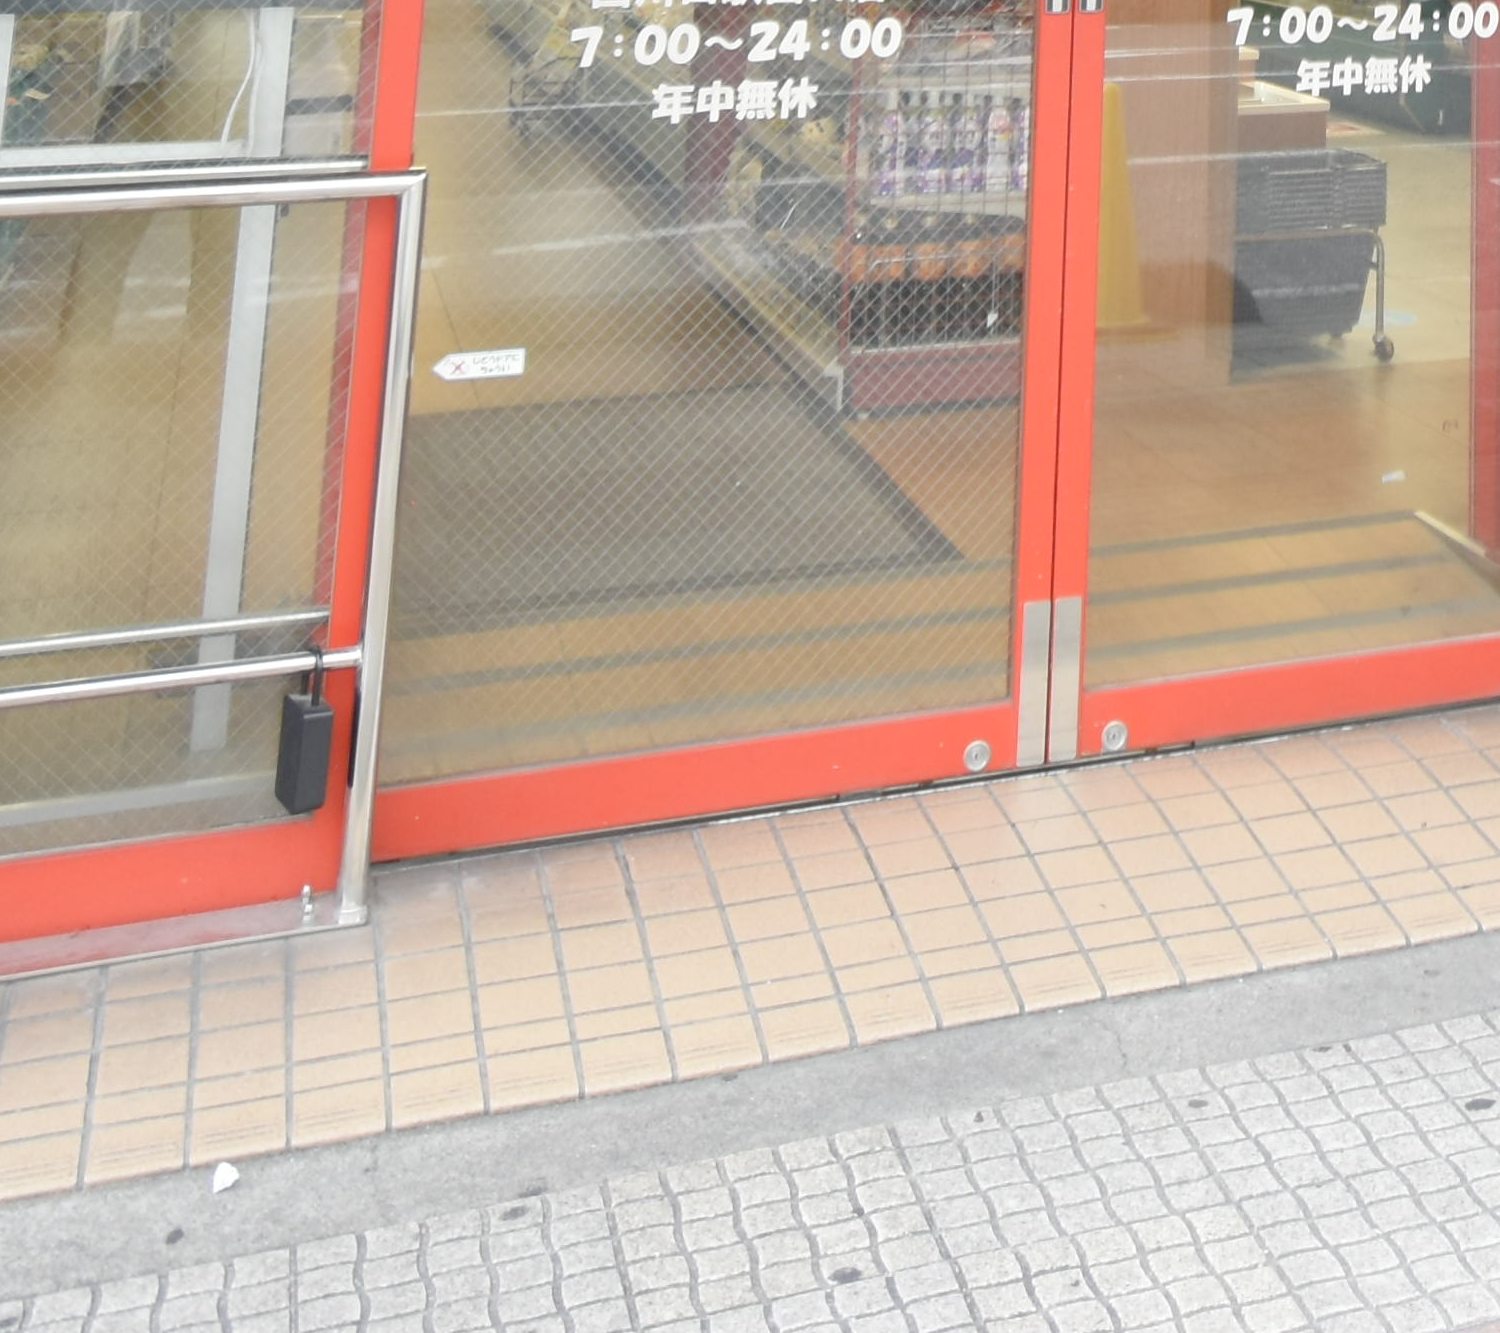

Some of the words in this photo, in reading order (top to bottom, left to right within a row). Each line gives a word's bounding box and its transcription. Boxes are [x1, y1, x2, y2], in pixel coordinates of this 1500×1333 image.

[1296, 54, 1433, 96] 年中無休
[651, 76, 819, 125] 年中無休
